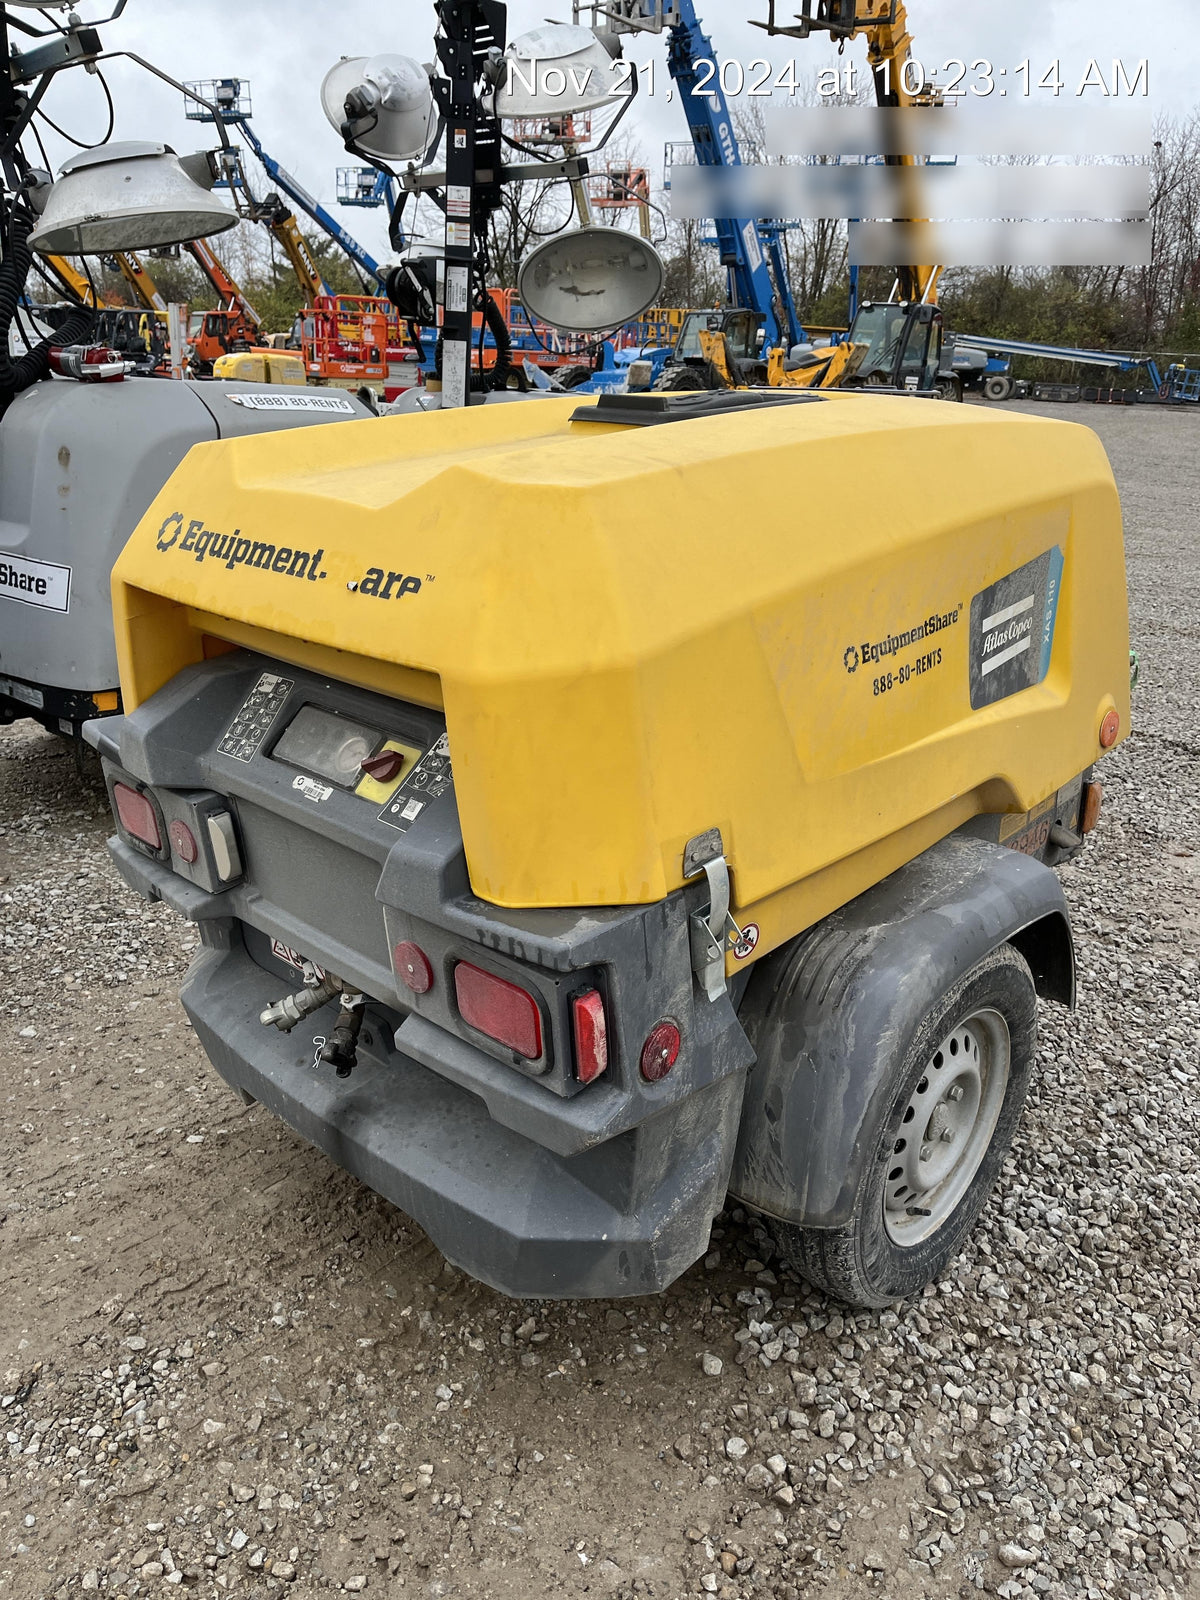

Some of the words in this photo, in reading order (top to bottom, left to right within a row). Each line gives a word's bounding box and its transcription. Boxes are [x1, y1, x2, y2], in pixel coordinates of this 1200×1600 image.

[248, 396, 287, 406] (888)
[290, 397, 349, 410] 80-RENTS
[1047, 578, 1057, 601] 110
[981, 629, 1009, 657] Atlas
[1008, 616, 1034, 641] Copco
[1042, 608, 1054, 646] XAS
[872, 647, 943, 697] 888-80-RENTS
